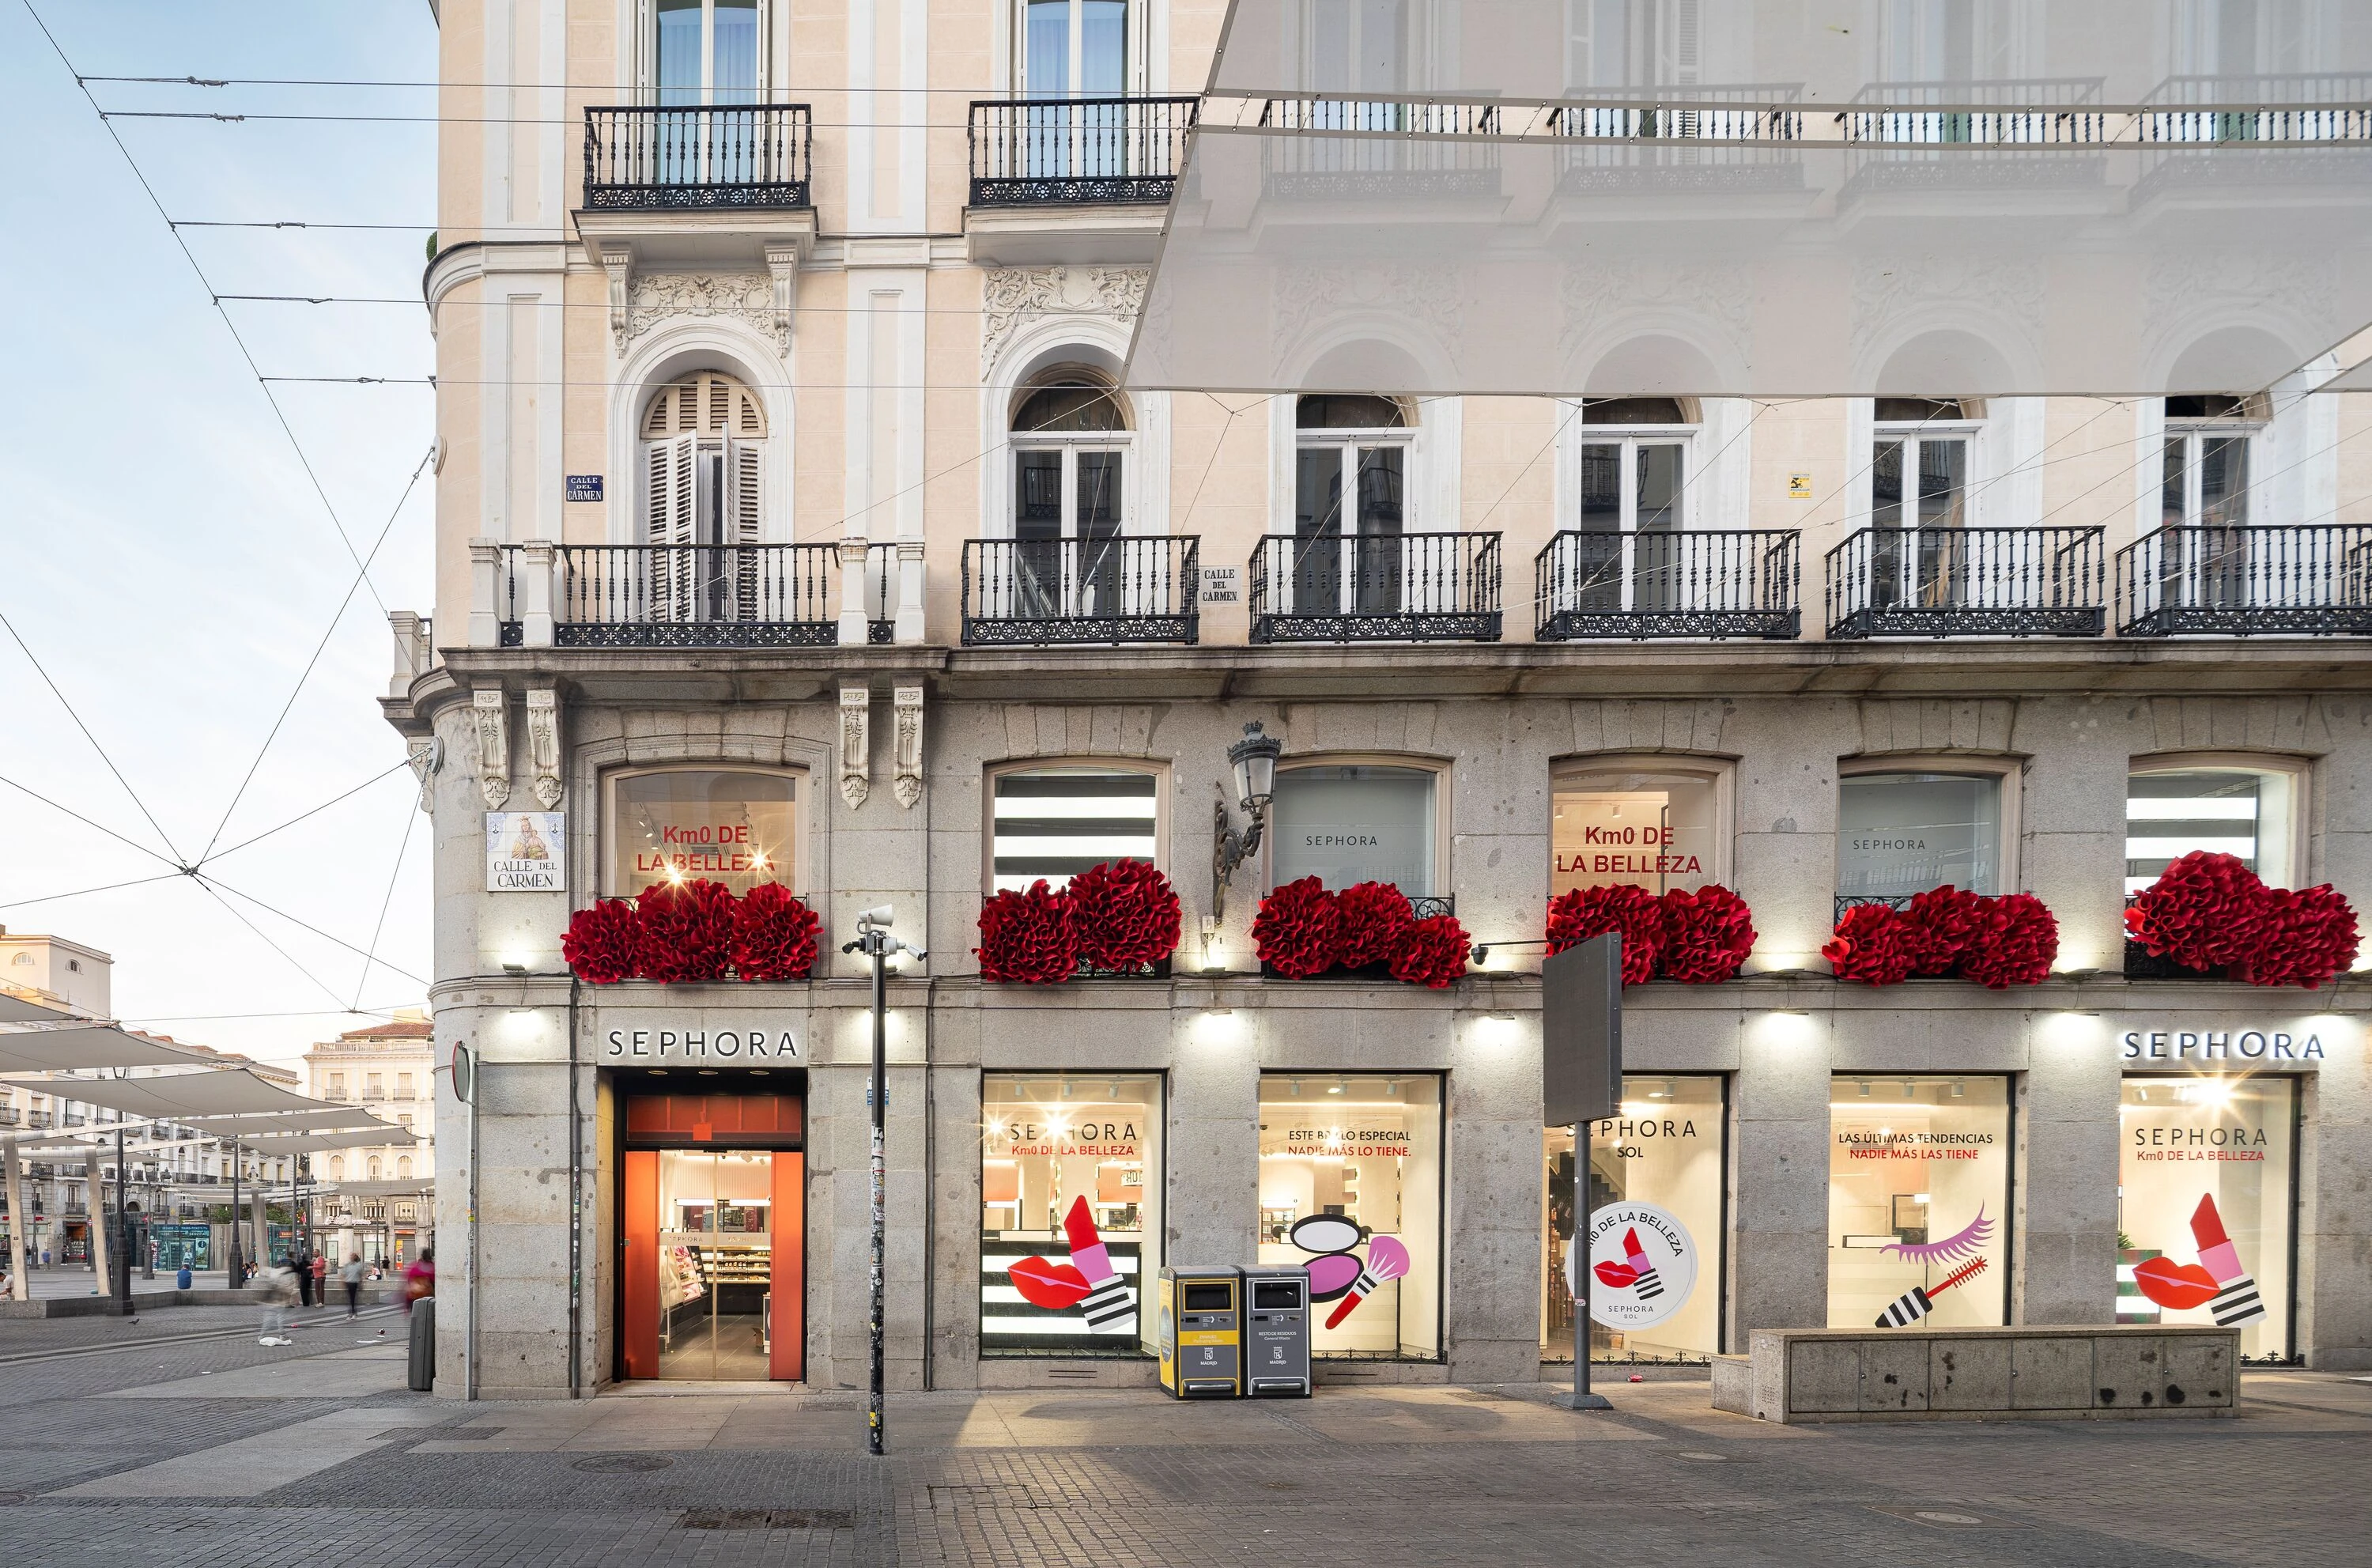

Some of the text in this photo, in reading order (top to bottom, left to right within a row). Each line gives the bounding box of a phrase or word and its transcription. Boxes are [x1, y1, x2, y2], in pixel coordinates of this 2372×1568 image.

[1204, 569, 1235, 579] CALLE
[663, 826, 748, 844] Km0 DE
[1306, 836, 1377, 846] SEPHORA
[1585, 827, 1674, 844] Km0 DE
[1853, 840, 1925, 849] SEPHORA
[493, 861, 532, 871] CALLE
[637, 854, 665, 871] LA
[1558, 856, 1702, 873] LA BELLEZA
[498, 874, 553, 888] CARMEN
[609, 1031, 796, 1056] SEPHORA
[2125, 1031, 2325, 1058] SEPHORA
[1289, 1131, 1313, 1140] ESTE
[1360, 1132, 1411, 1140] ESPECIAL
[1839, 1131, 1992, 1143] LAS ÚLTIMAS TENDENCIAS
[2136, 1128, 2267, 1146] SEPHORA
[1012, 1146, 1134, 1155] Km0 DE LA BELLEZA
[1289, 1144, 1411, 1157] NADIE MÁS LO TIENE.
[1618, 1147, 1643, 1158] SOL
[1850, 1147, 1978, 1159] NADIE MÁS LAS TIENE
[2137, 1151, 2264, 1161] Km0 DE LA BELLEZA
[1598, 1216, 1616, 1232] DE
[1618, 1211, 1636, 1222] LA
[1639, 1213, 1683, 1257] BELLEZA
